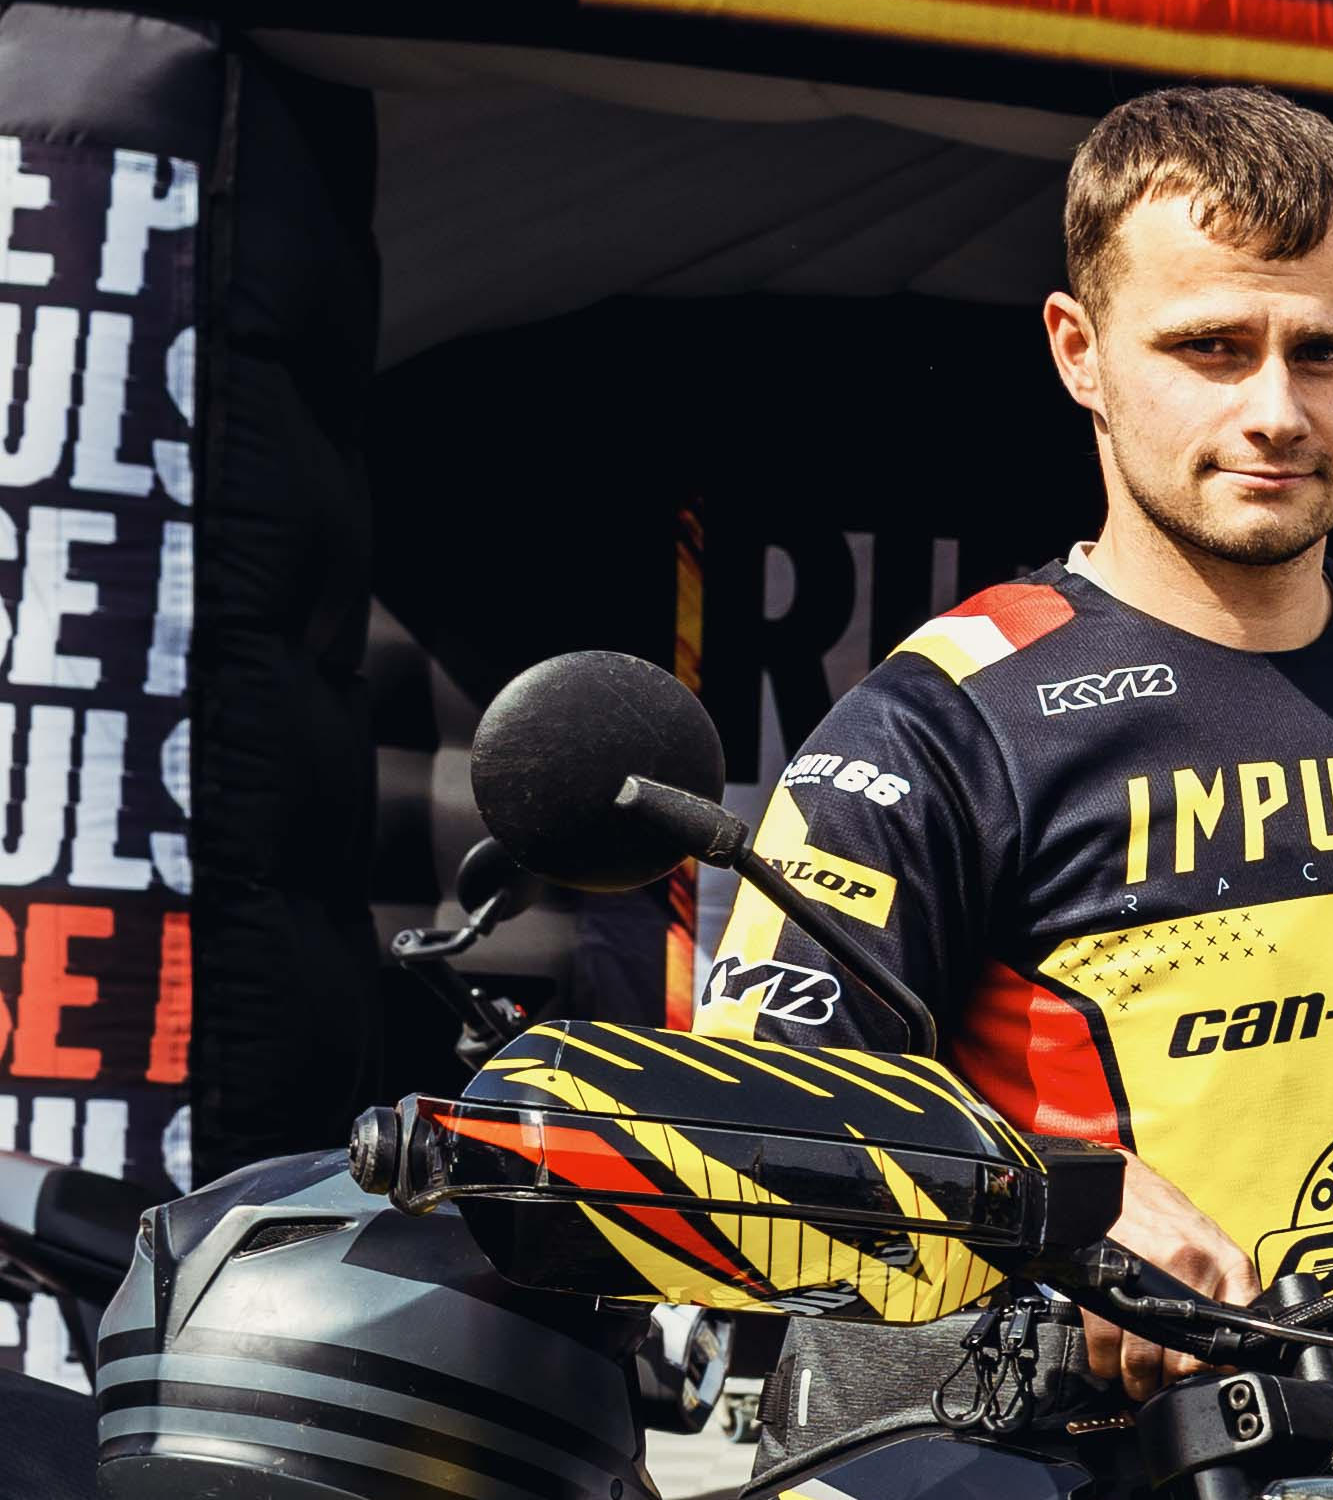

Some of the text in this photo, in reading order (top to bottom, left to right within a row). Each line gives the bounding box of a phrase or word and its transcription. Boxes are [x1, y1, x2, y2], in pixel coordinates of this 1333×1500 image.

[1036, 662, 1178, 716] KYB
[833, 759, 912, 807] 66
[763, 857, 877, 901] NLOP
